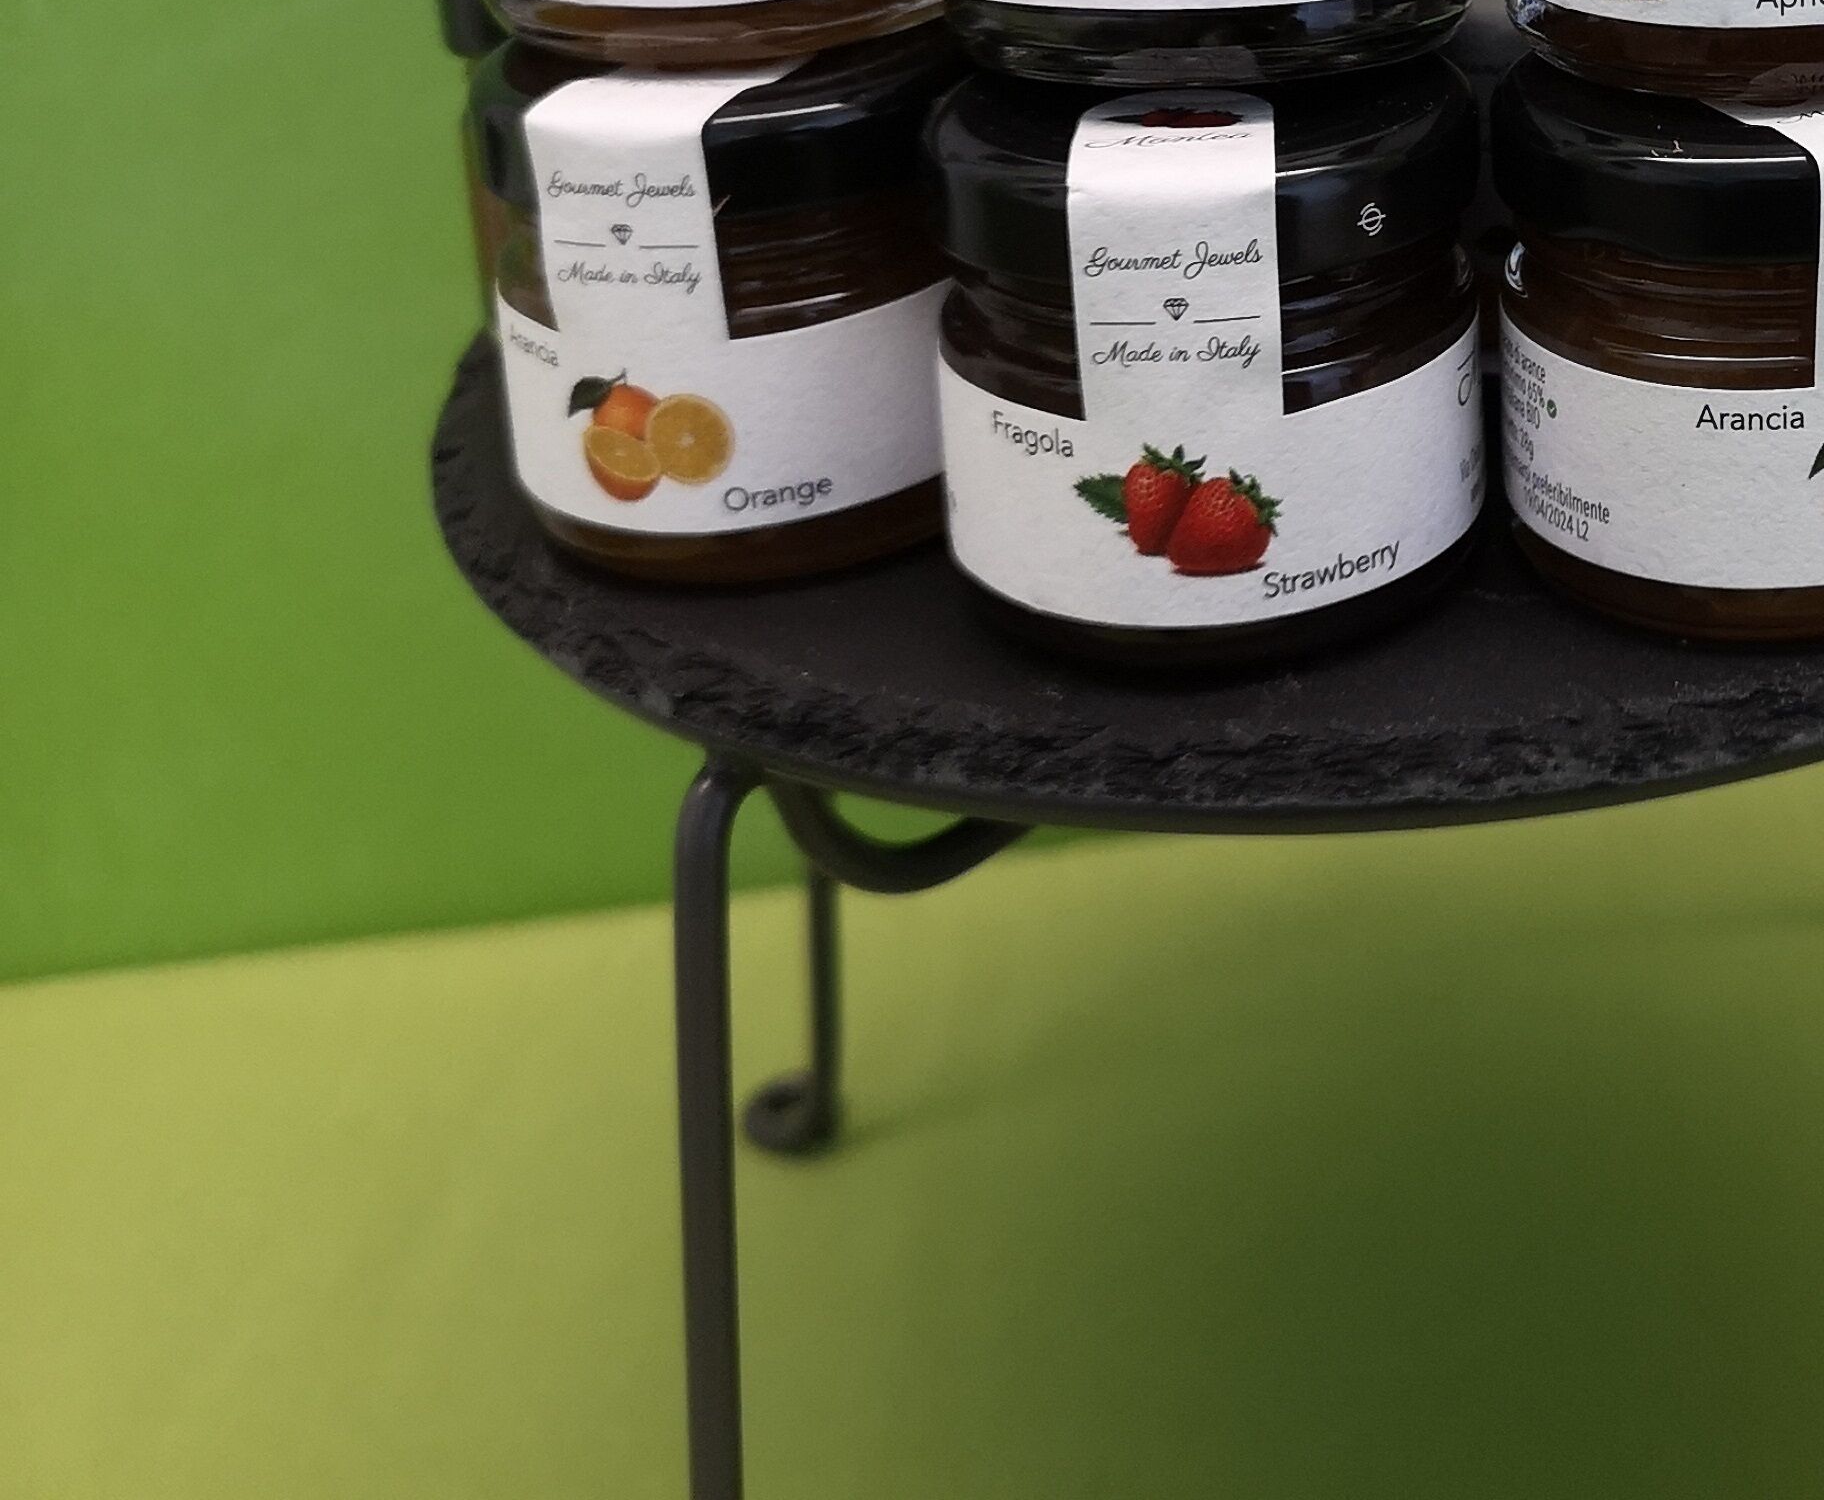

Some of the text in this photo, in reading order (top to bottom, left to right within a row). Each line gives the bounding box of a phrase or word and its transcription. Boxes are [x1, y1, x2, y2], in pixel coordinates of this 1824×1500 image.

[547, 171, 696, 208] Gourmet Jewels
[557, 261, 701, 293] Made in Italy
[1084, 239, 1263, 280] Gourmet Jewels
[1091, 335, 1260, 369] Made in Italy
[992, 410, 1074, 458] Fragola
[1696, 404, 1805, 432] Arancia
[723, 474, 833, 512] Orange
[1576, 516, 1589, 542] L2
[1263, 539, 1400, 600] Strawberry
